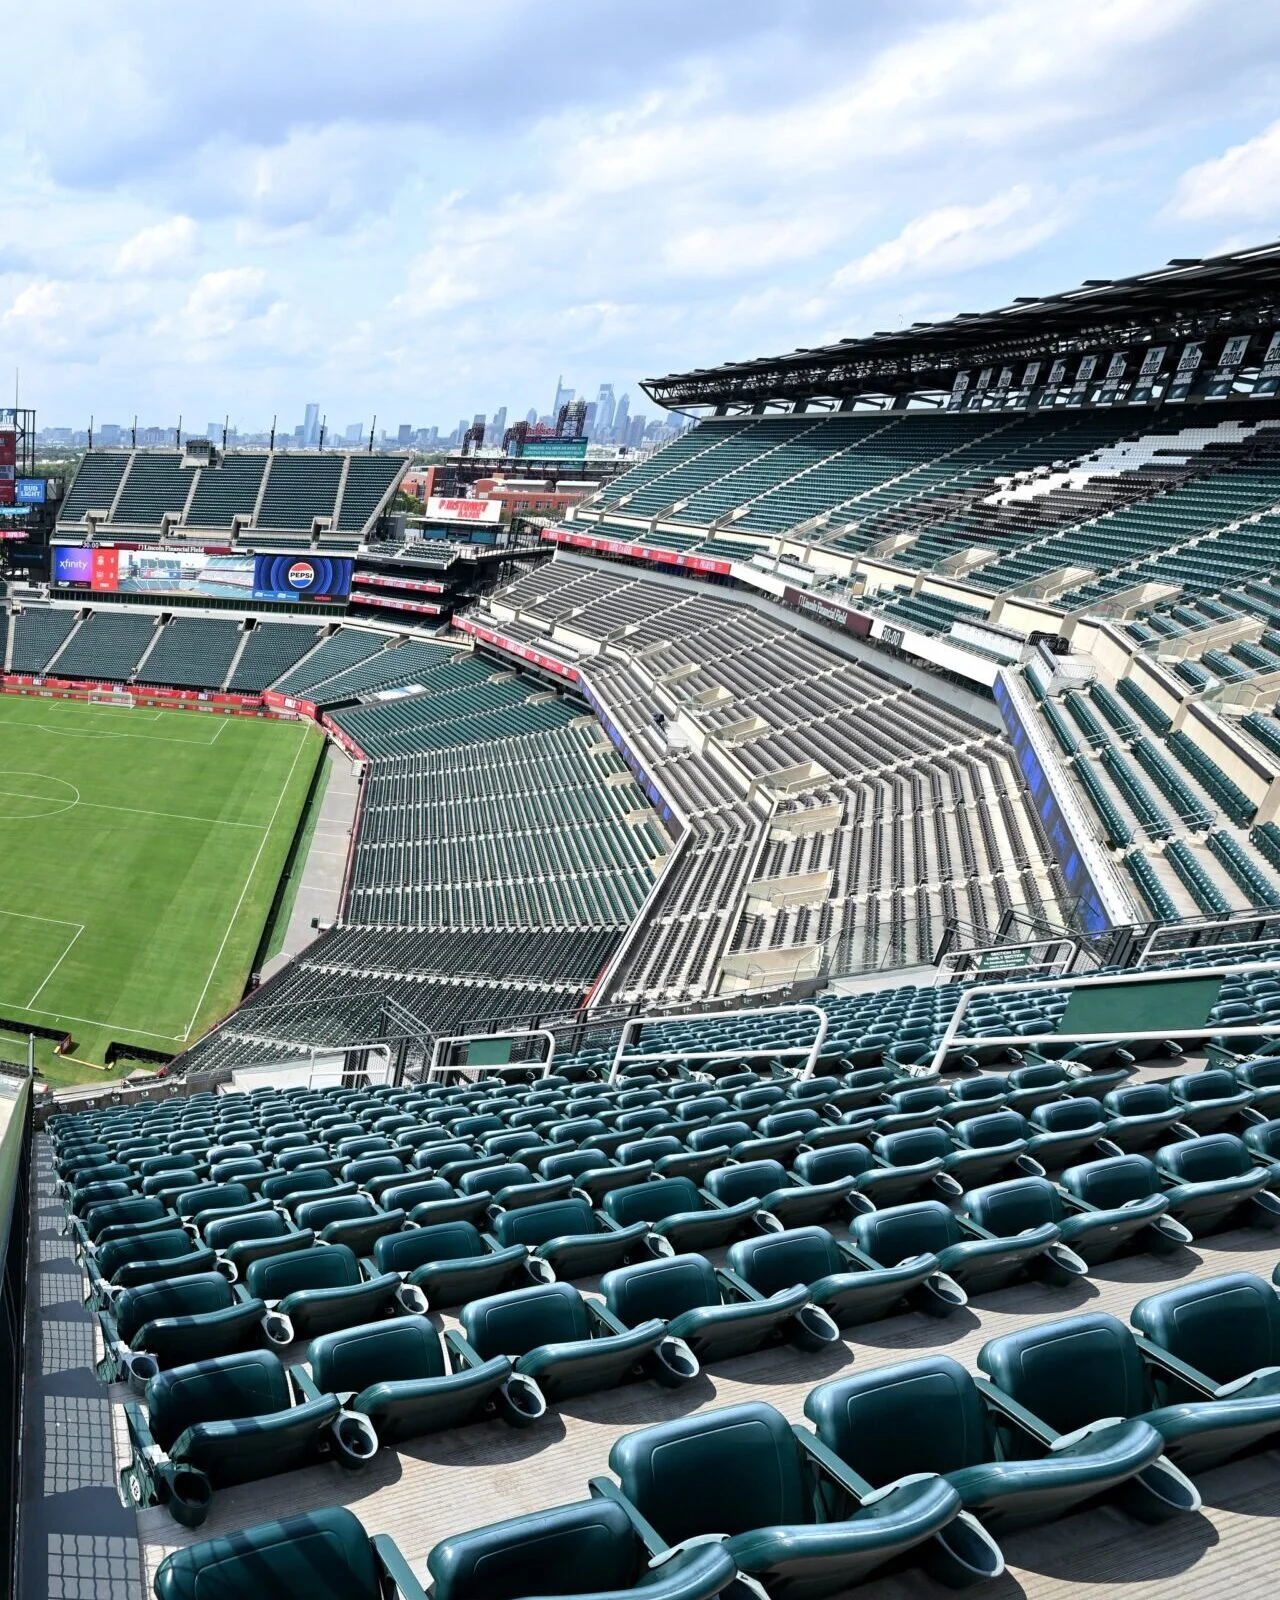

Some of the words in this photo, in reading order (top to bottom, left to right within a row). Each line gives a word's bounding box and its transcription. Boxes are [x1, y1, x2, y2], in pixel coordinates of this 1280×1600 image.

[1180, 357, 1199, 369] 2003
[1221, 351, 1242, 364] 2004
[60, 559, 88, 569] xfinity
[881, 627, 901, 645] 30:00
